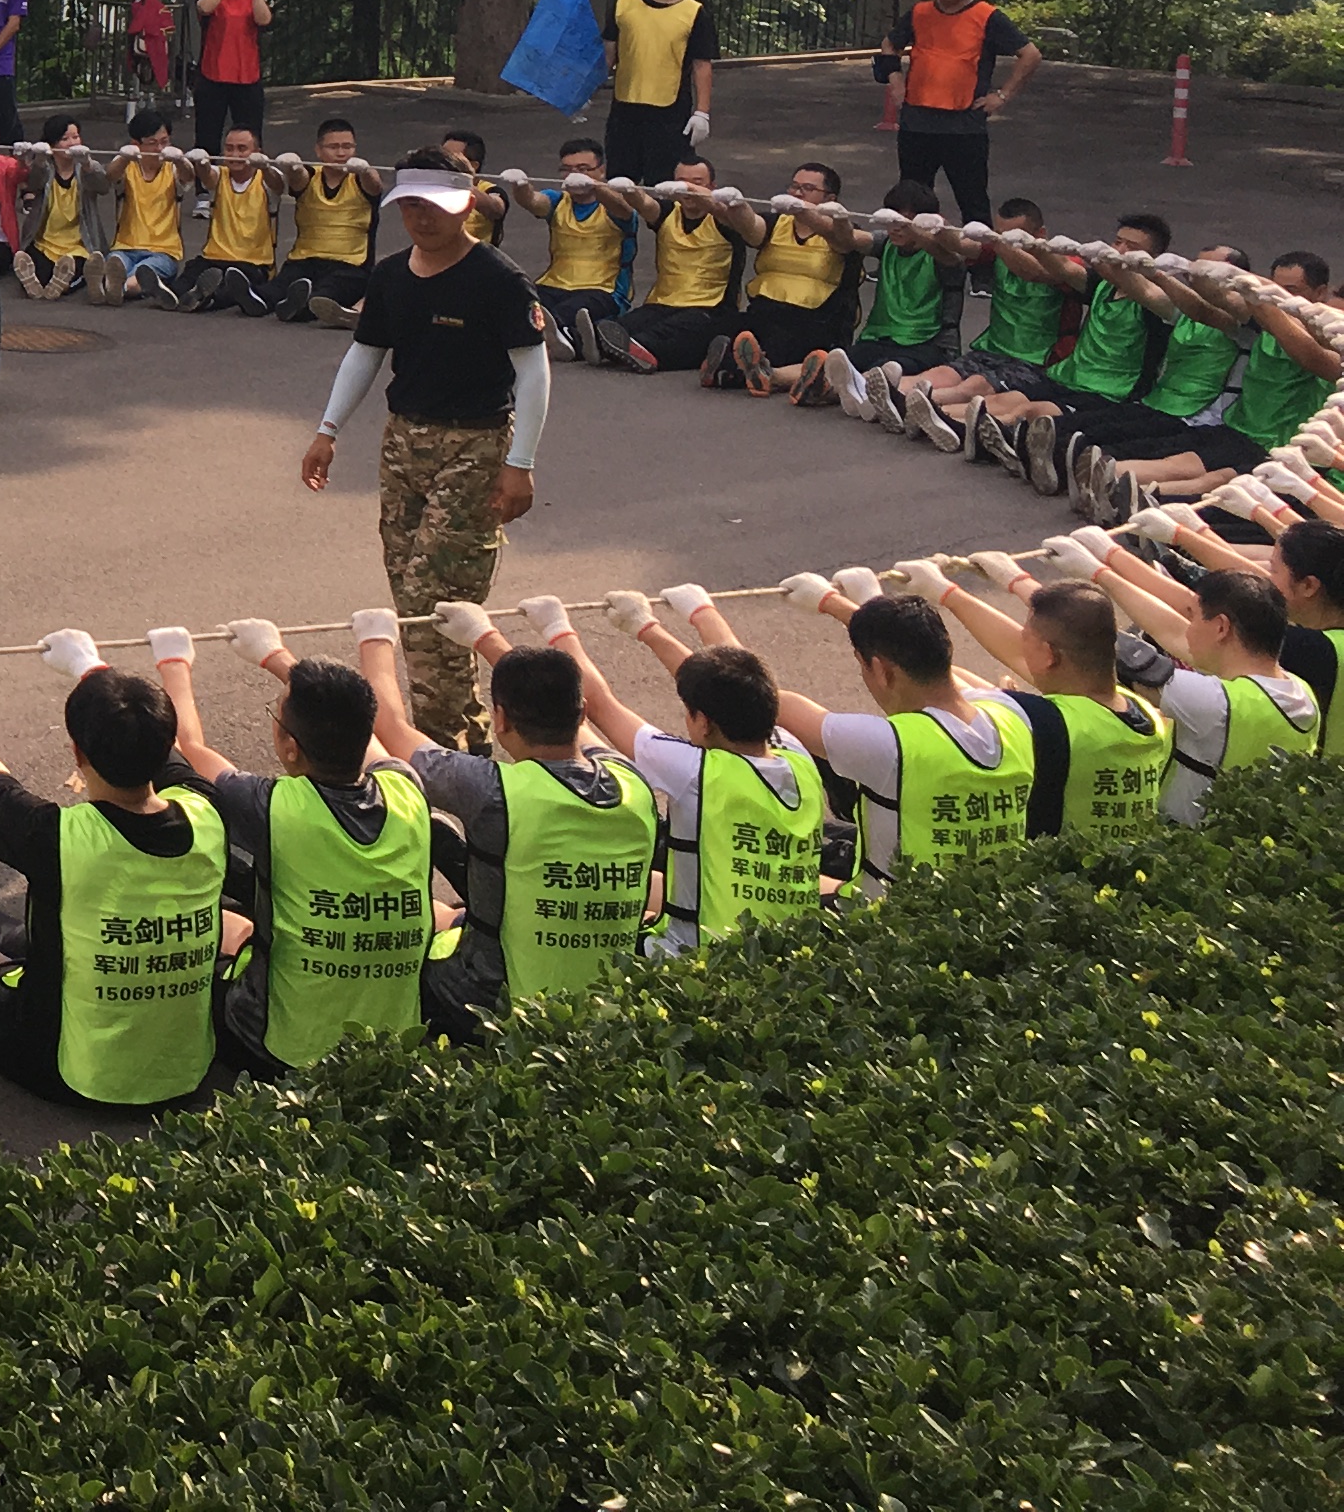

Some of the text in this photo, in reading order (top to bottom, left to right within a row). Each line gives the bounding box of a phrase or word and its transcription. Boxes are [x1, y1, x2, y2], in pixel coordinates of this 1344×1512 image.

[1093, 764, 1157, 796] 亮剑中
[1091, 801, 1127, 819] 军训
[931, 829, 972, 847] 军训
[543, 861, 644, 891] 亮剑中国
[731, 857, 770, 881] 军训
[309, 889, 422, 922] 亮剑中国
[534, 898, 578, 920] 军训
[100, 905, 213, 945] 亮剑中国
[301, 926, 424, 952] 军训 拓展训练
[93, 941, 215, 975] 军训 拓展训练
[301, 957, 419, 979] 15069130959
